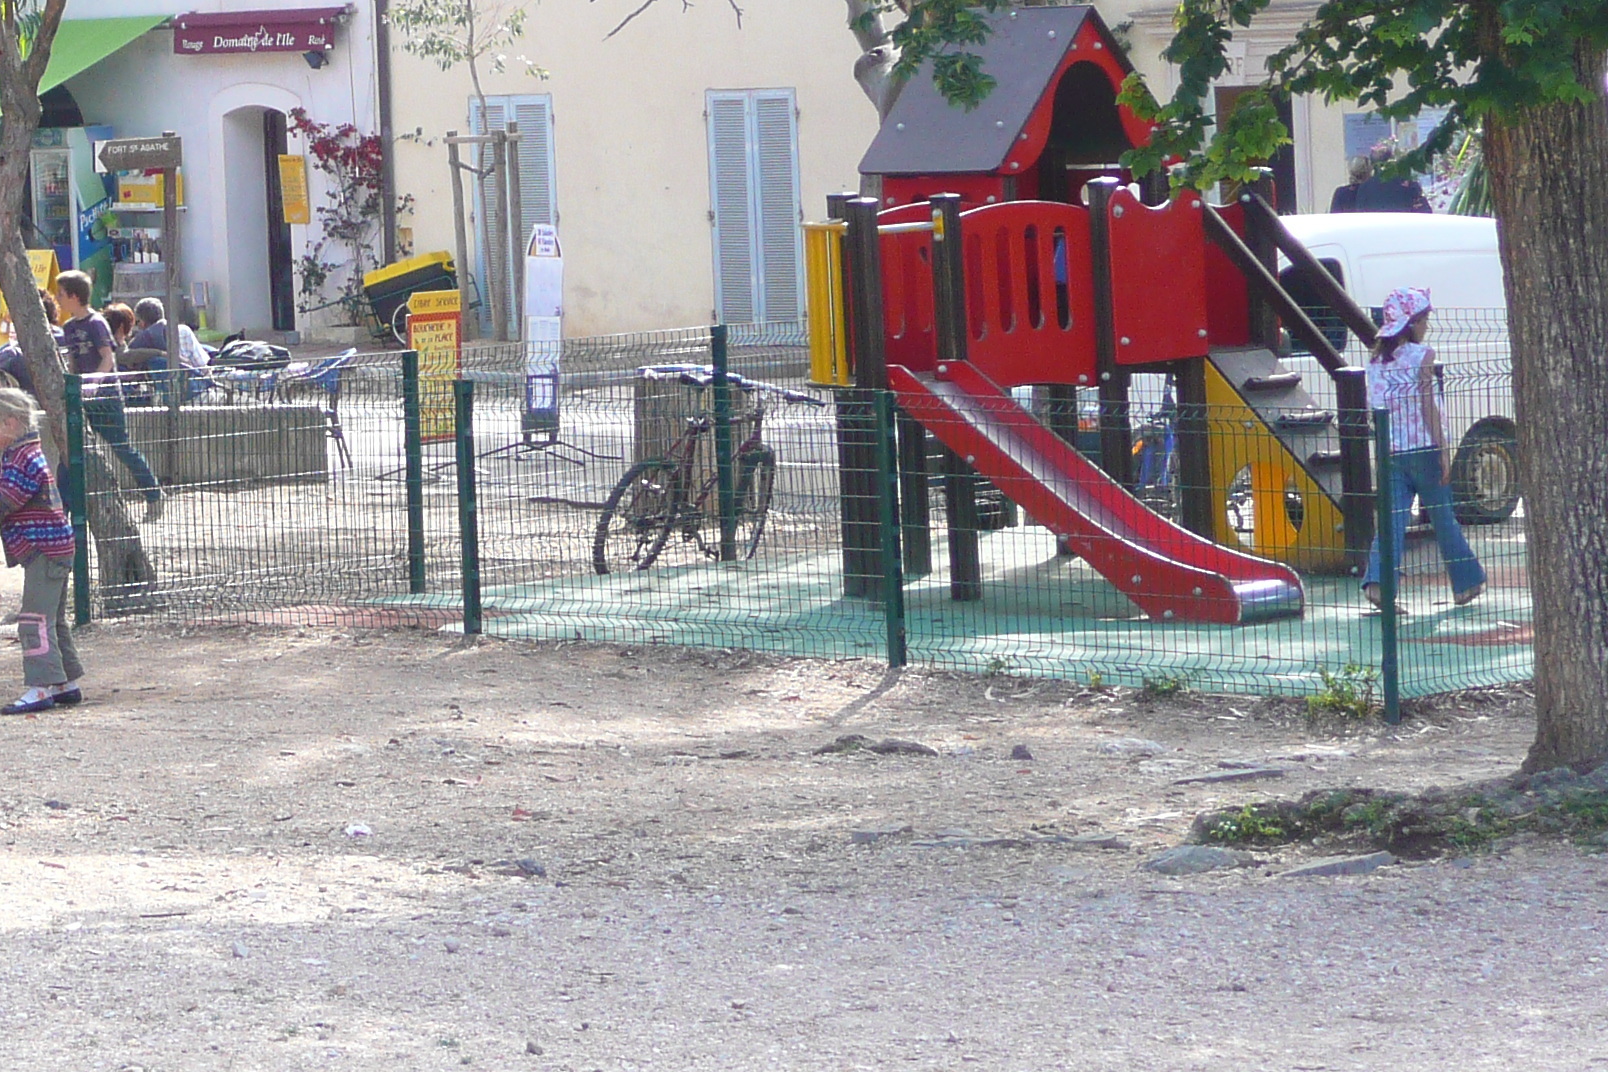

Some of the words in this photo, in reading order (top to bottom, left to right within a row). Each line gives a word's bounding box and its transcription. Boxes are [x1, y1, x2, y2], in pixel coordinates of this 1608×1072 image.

[213, 34, 259, 48] Domaine
[261, 34, 274, 46] de
[107, 145, 127, 155] FORT
[140, 142, 169, 153] AGATHE
